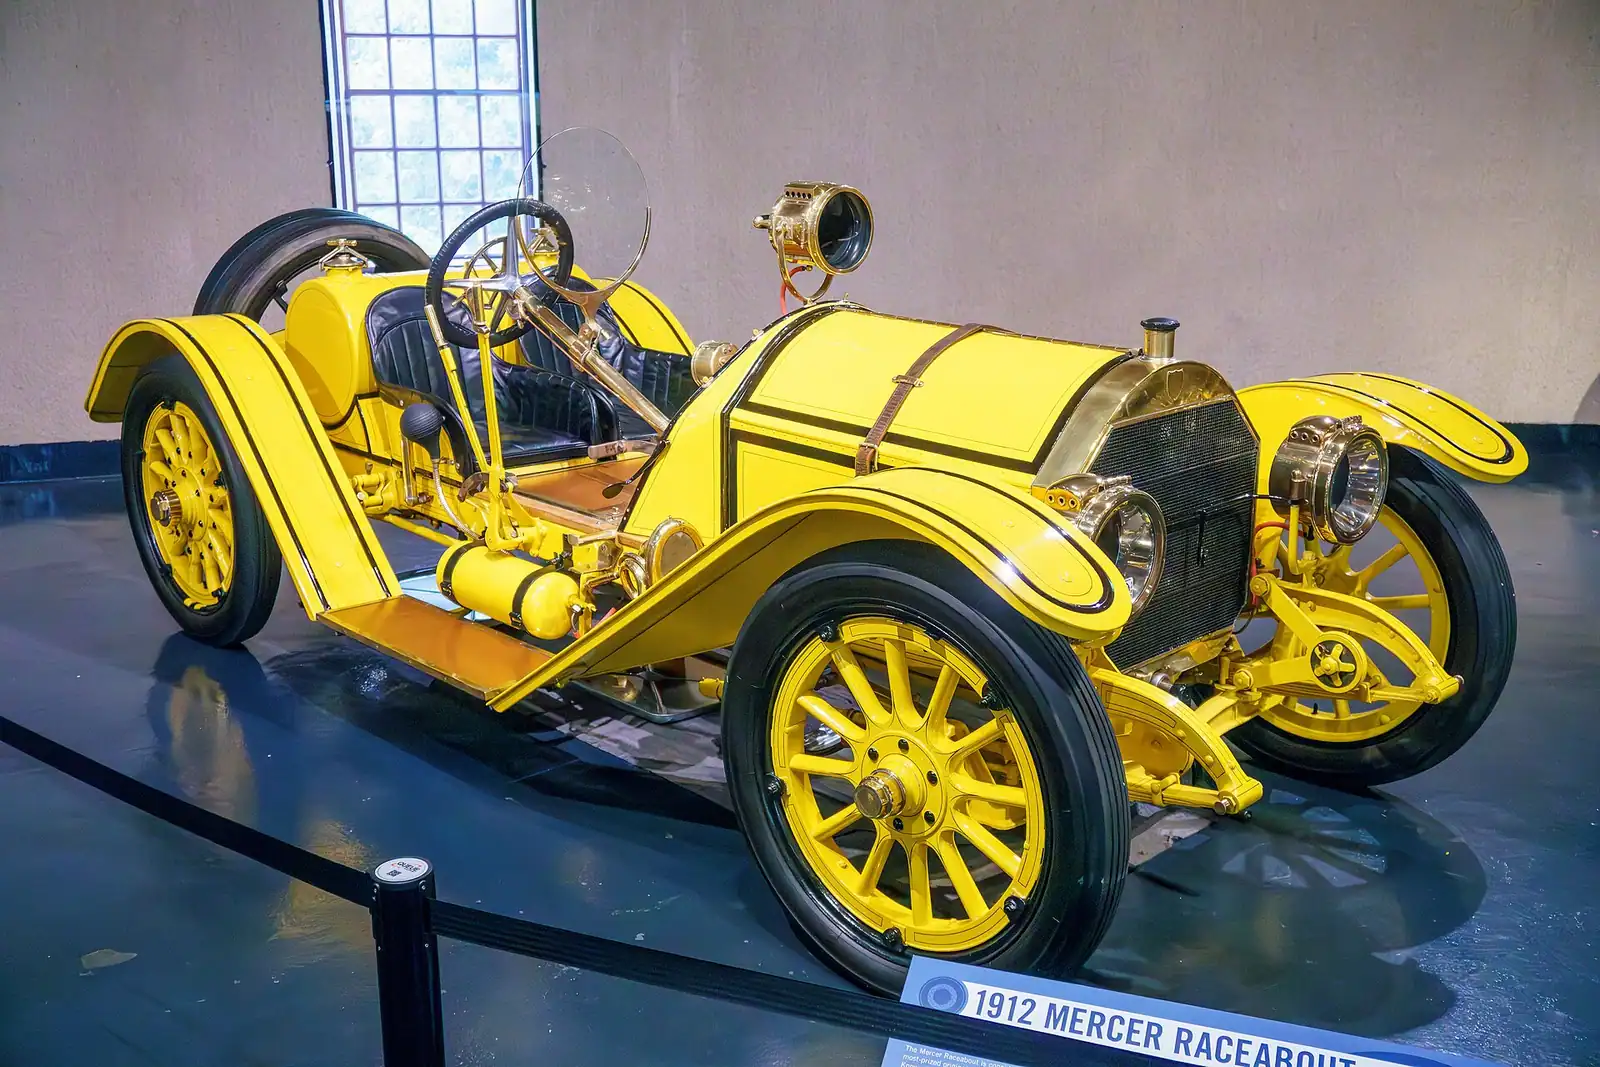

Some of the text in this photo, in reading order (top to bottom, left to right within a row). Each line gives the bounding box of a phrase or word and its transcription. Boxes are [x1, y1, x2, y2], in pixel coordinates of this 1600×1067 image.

[976, 989, 1037, 1026] 1912
[1044, 1002, 1163, 1051] MERCER
[903, 1054, 942, 1066] most-prized
[905, 1045, 917, 1053] The
[919, 1047, 943, 1058] Mercer
[944, 1052, 979, 1065] Raceabout
